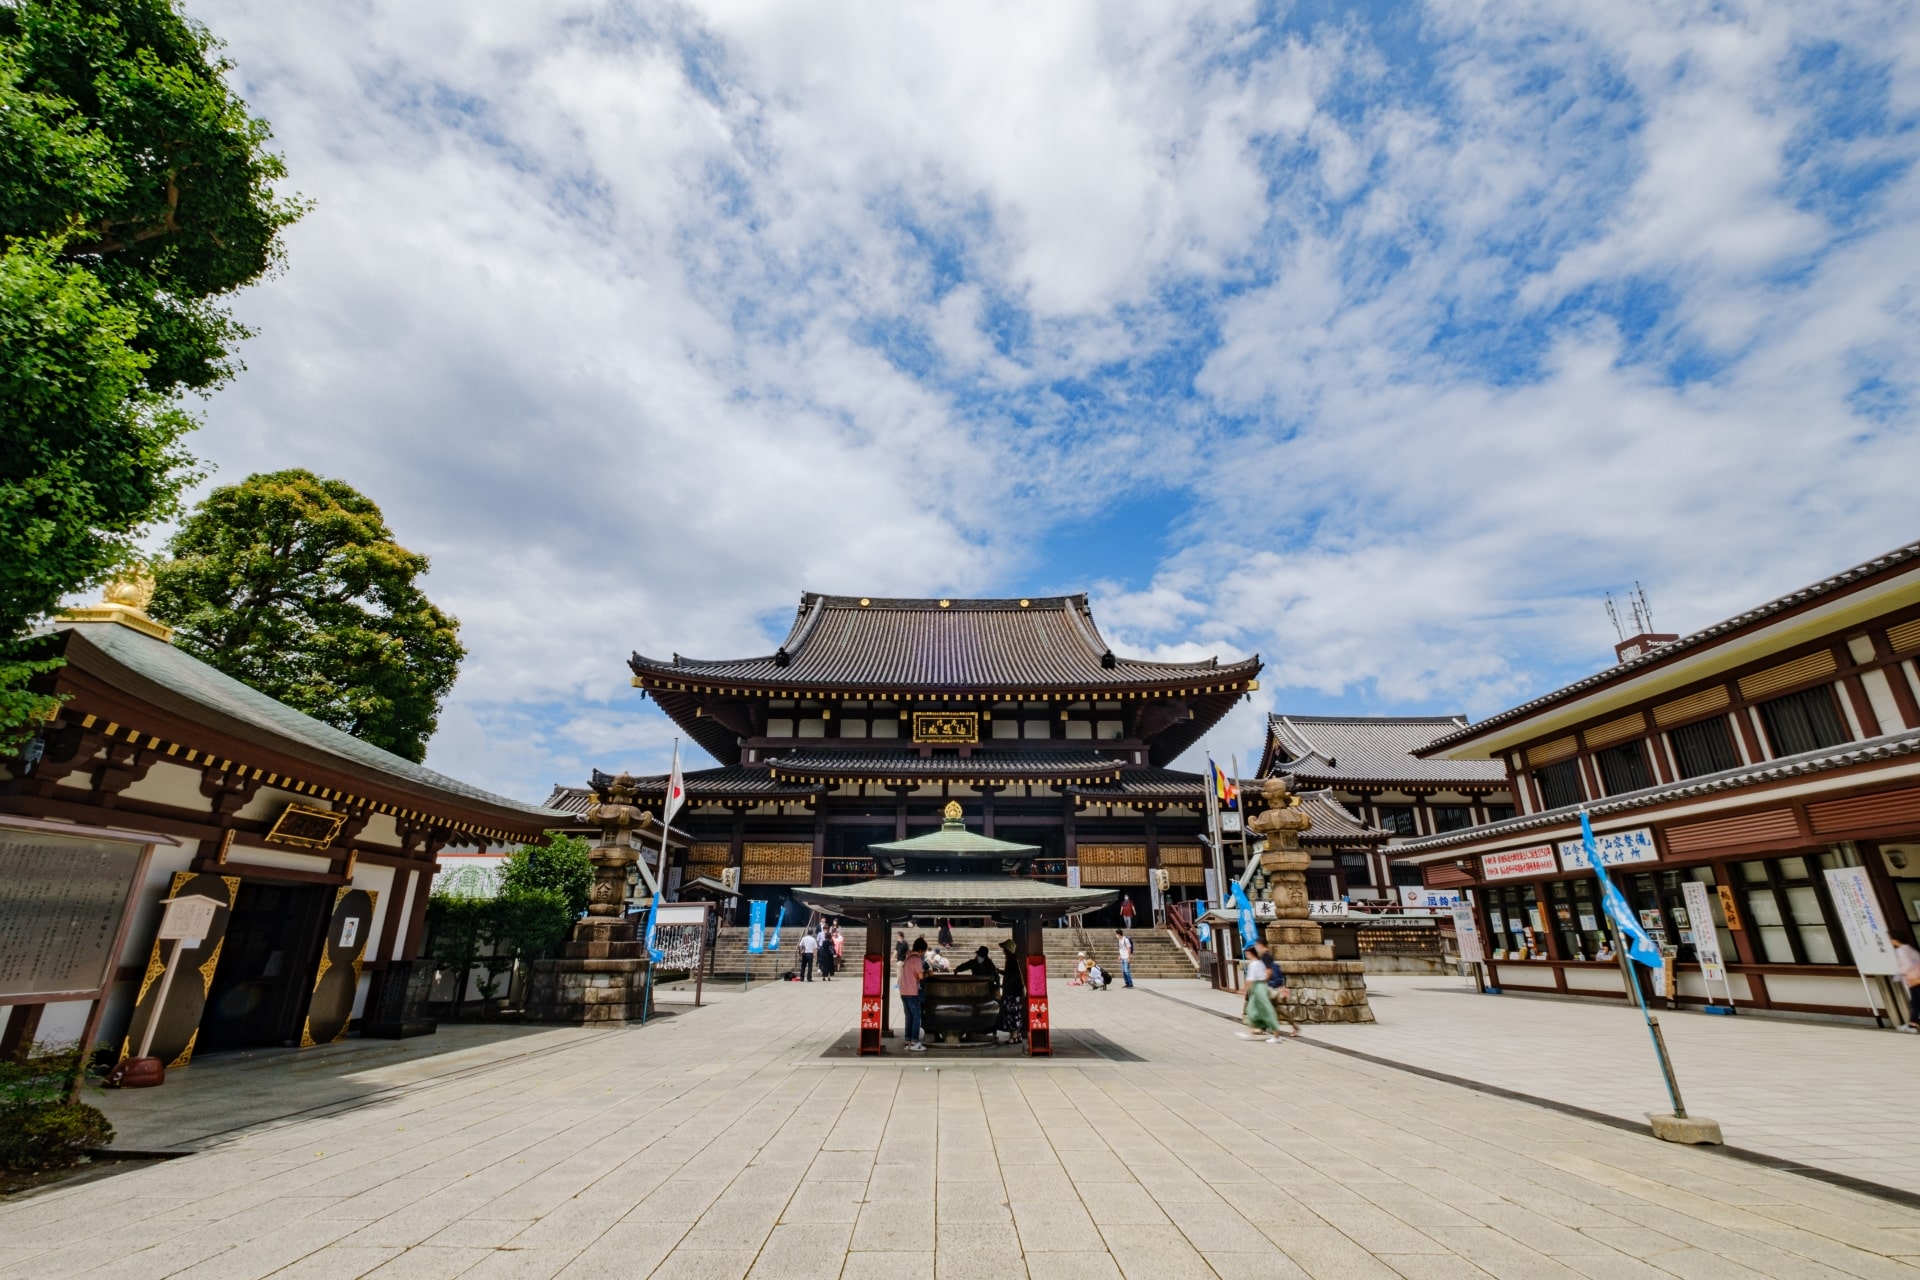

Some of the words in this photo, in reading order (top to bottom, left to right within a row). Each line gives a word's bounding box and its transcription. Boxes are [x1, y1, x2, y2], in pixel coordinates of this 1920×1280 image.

[1575, 848, 1641, 867] 志受付所
[863, 1002, 881, 1012] 献香
[1029, 1002, 1047, 1012] 献香
